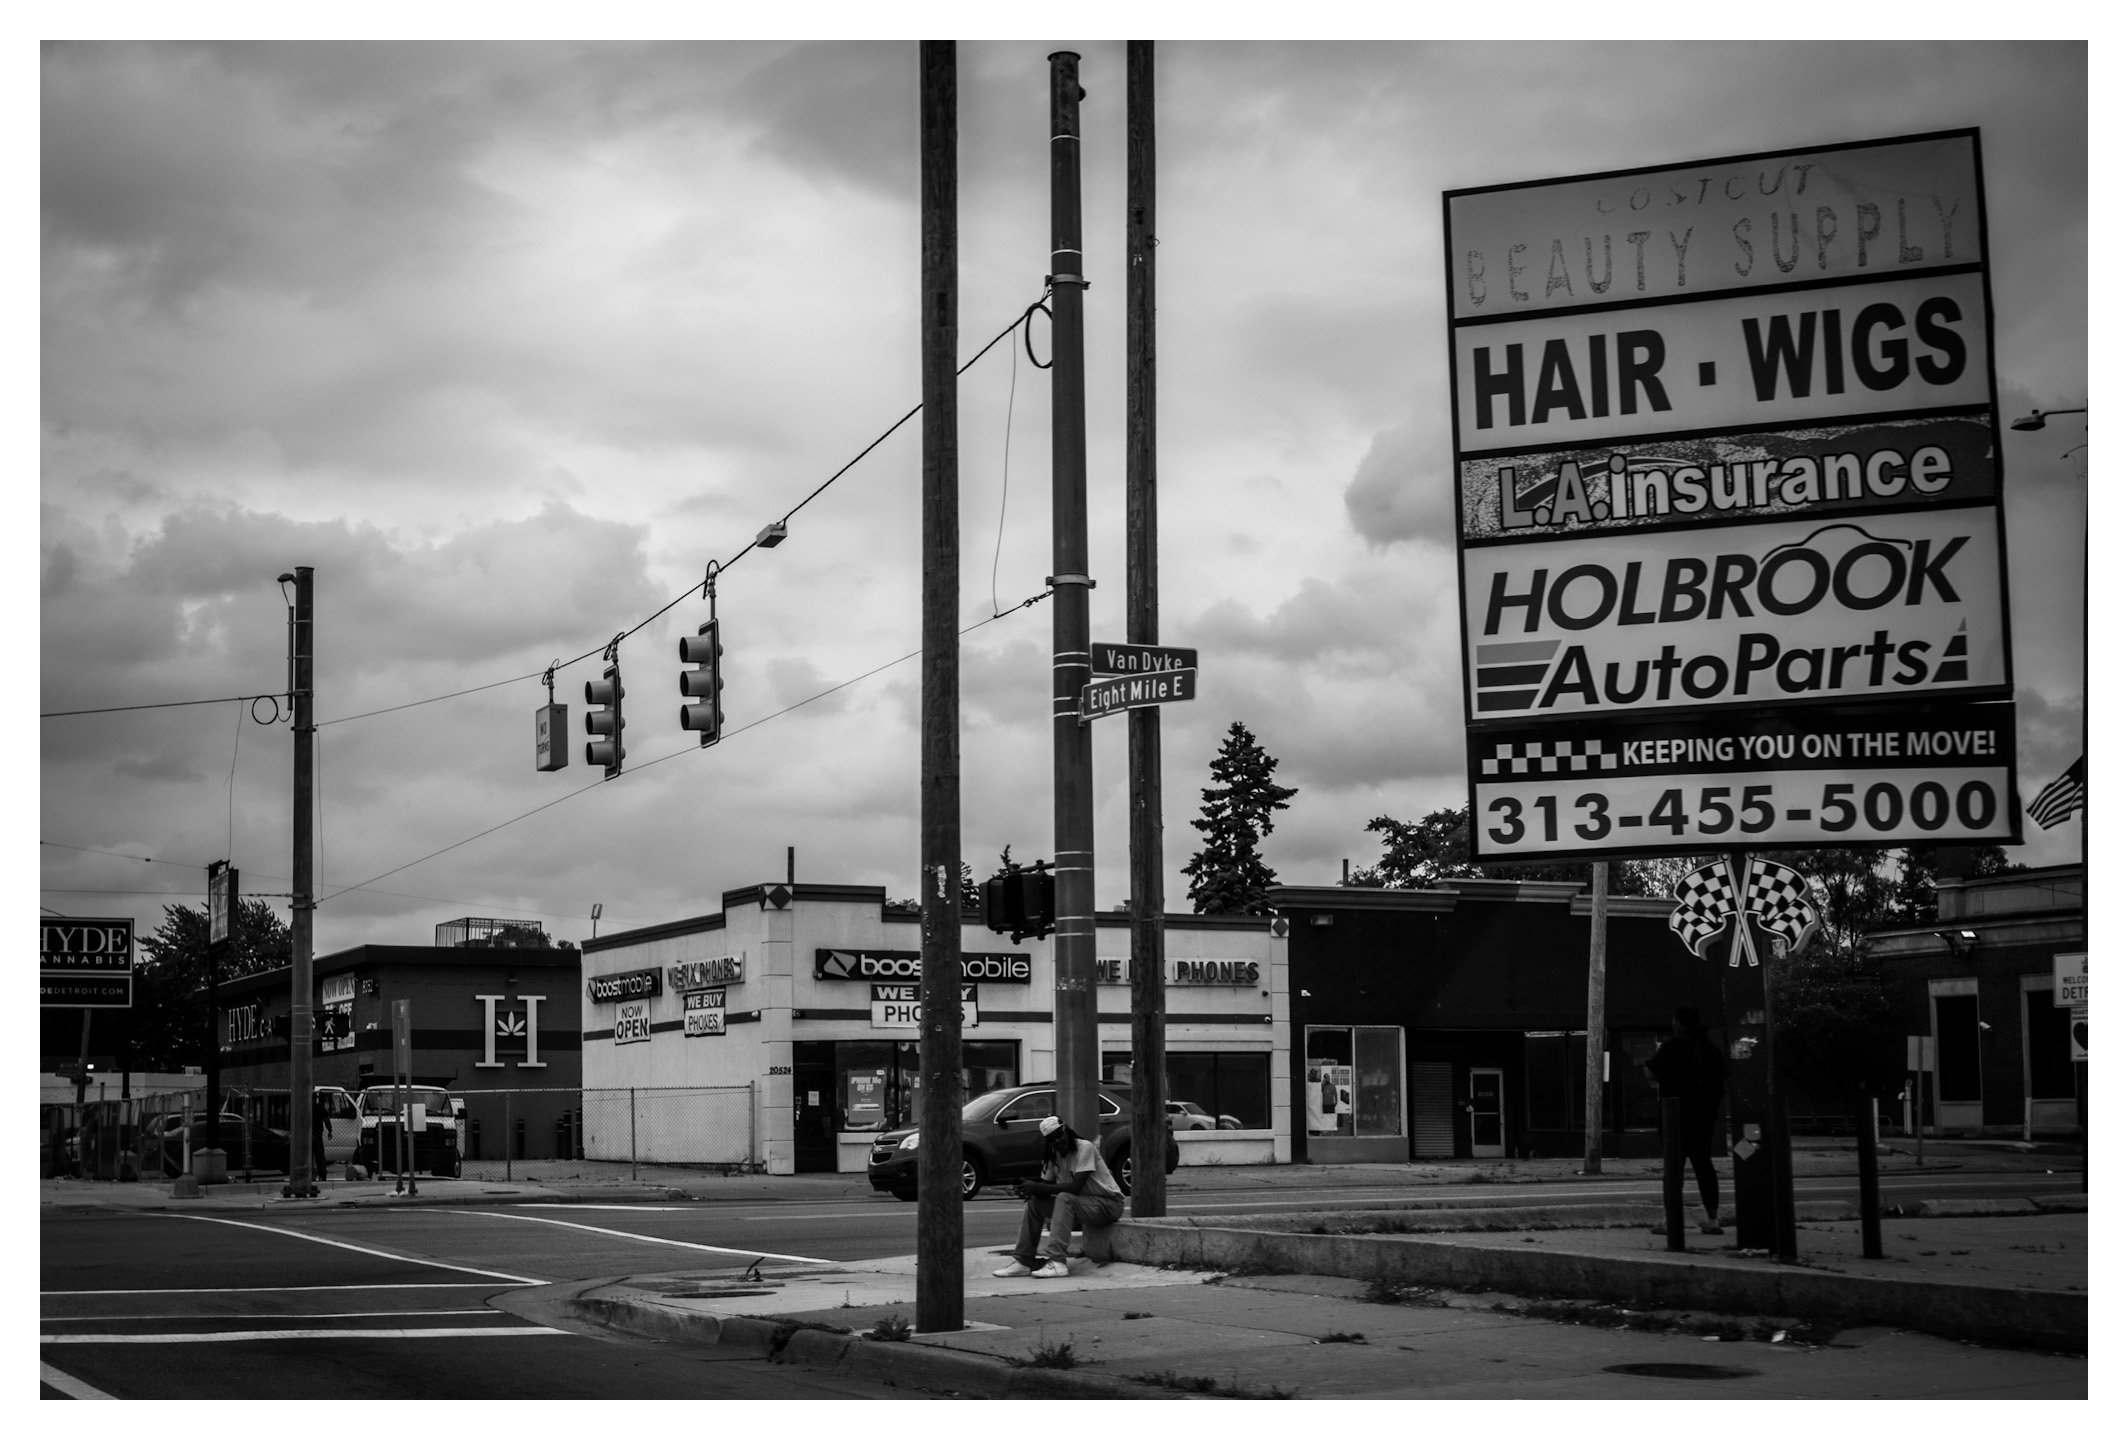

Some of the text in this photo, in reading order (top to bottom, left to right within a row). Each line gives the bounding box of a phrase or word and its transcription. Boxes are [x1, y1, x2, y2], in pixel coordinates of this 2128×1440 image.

[1466, 195, 1959, 308] BEAUTY SUPPLY
[1472, 296, 1967, 430] HAIR WIGS
[1483, 535, 1972, 636] HOLBROOK
[1106, 649, 1183, 672] Van Dyke
[1090, 675, 1183, 710] Eight Mile E
[1622, 730, 1996, 767] KEEPING YOU ON THE MOVE!
[1487, 780, 1997, 846] 313-455-5000
[1176, 961, 1260, 982] PHONES
[687, 993, 724, 1009] WE BUY
[876, 986, 914, 1000] WE
[228, 1004, 258, 1042] HYDE
[621, 1005, 643, 1019] NOW
[688, 1013, 719, 1032] PHONES
[616, 1018, 649, 1039] OPEN
